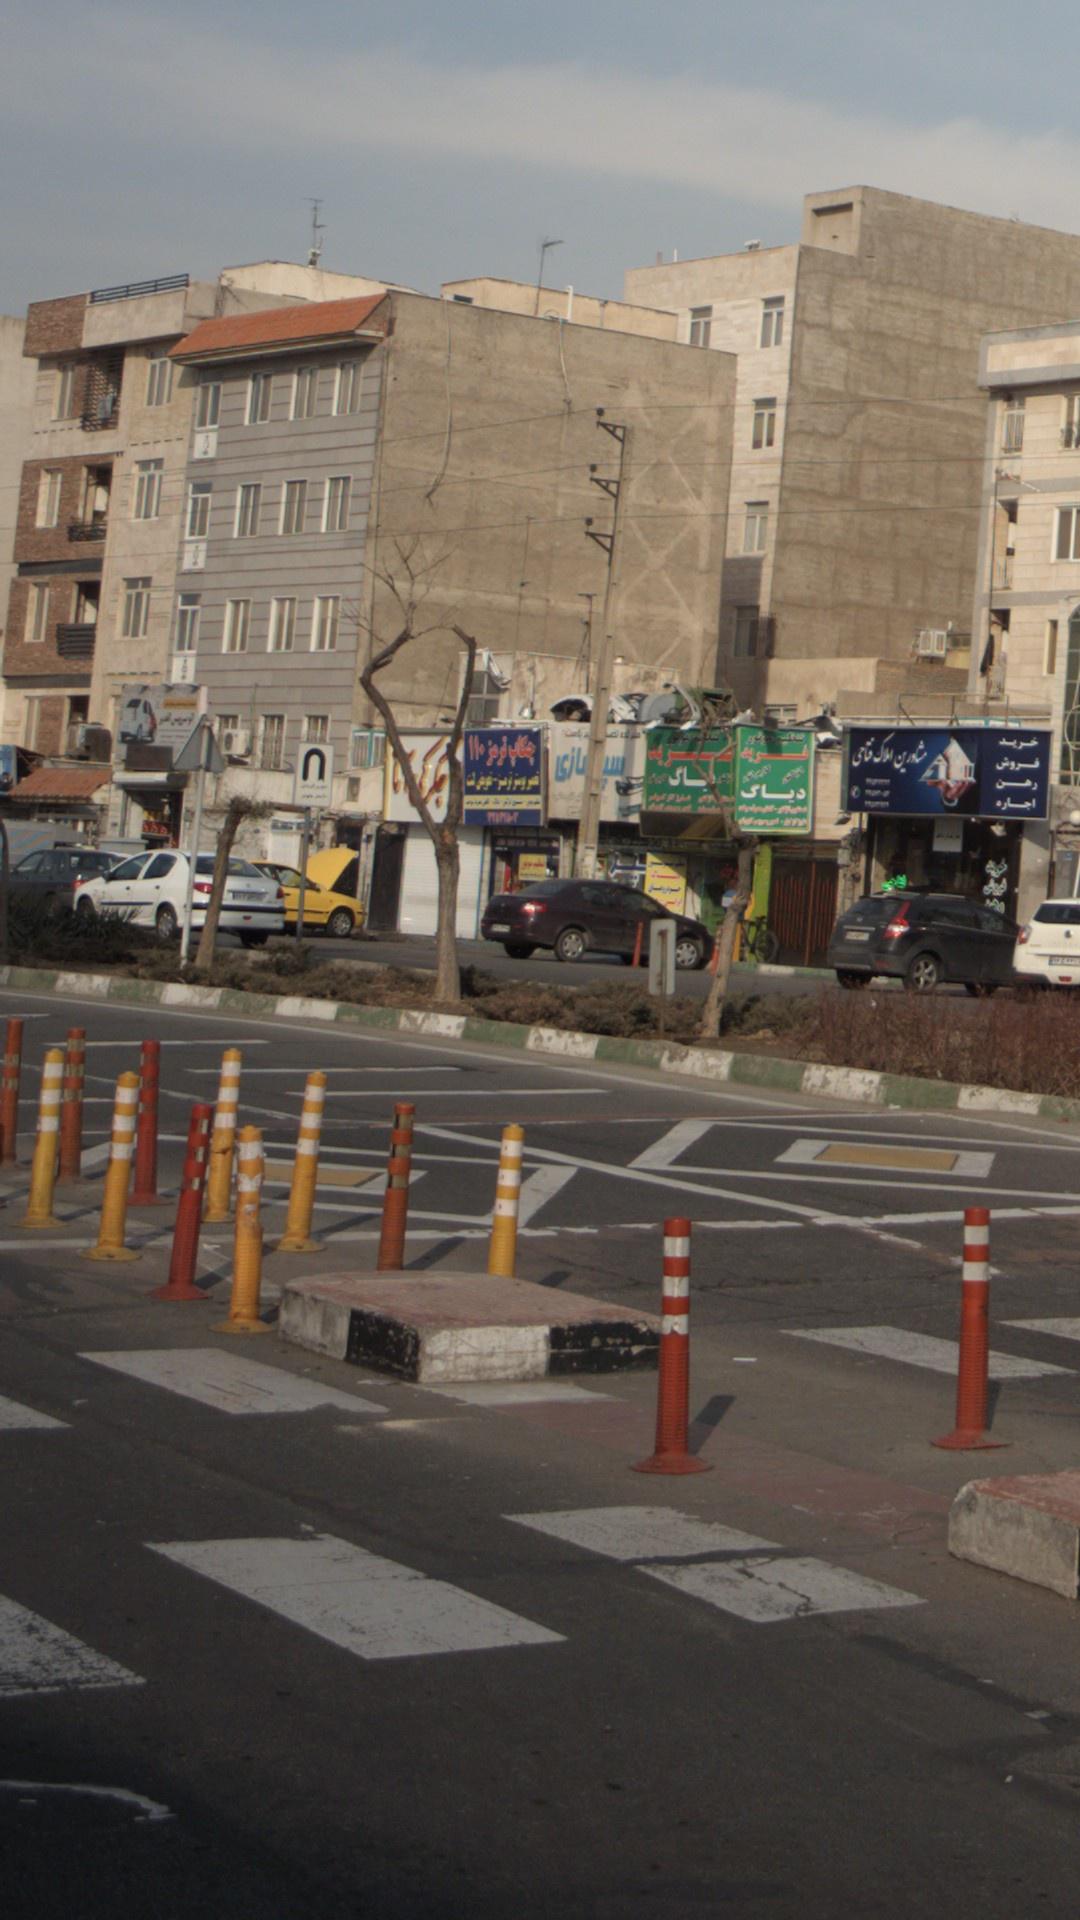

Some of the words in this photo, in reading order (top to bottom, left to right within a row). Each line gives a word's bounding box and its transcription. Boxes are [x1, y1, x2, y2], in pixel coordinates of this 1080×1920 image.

[998, 737, 1039, 750] خرید
[995, 756, 1040, 771] فروش
[995, 778, 1038, 791] رهن
[995, 797, 1036, 811] اجاره
